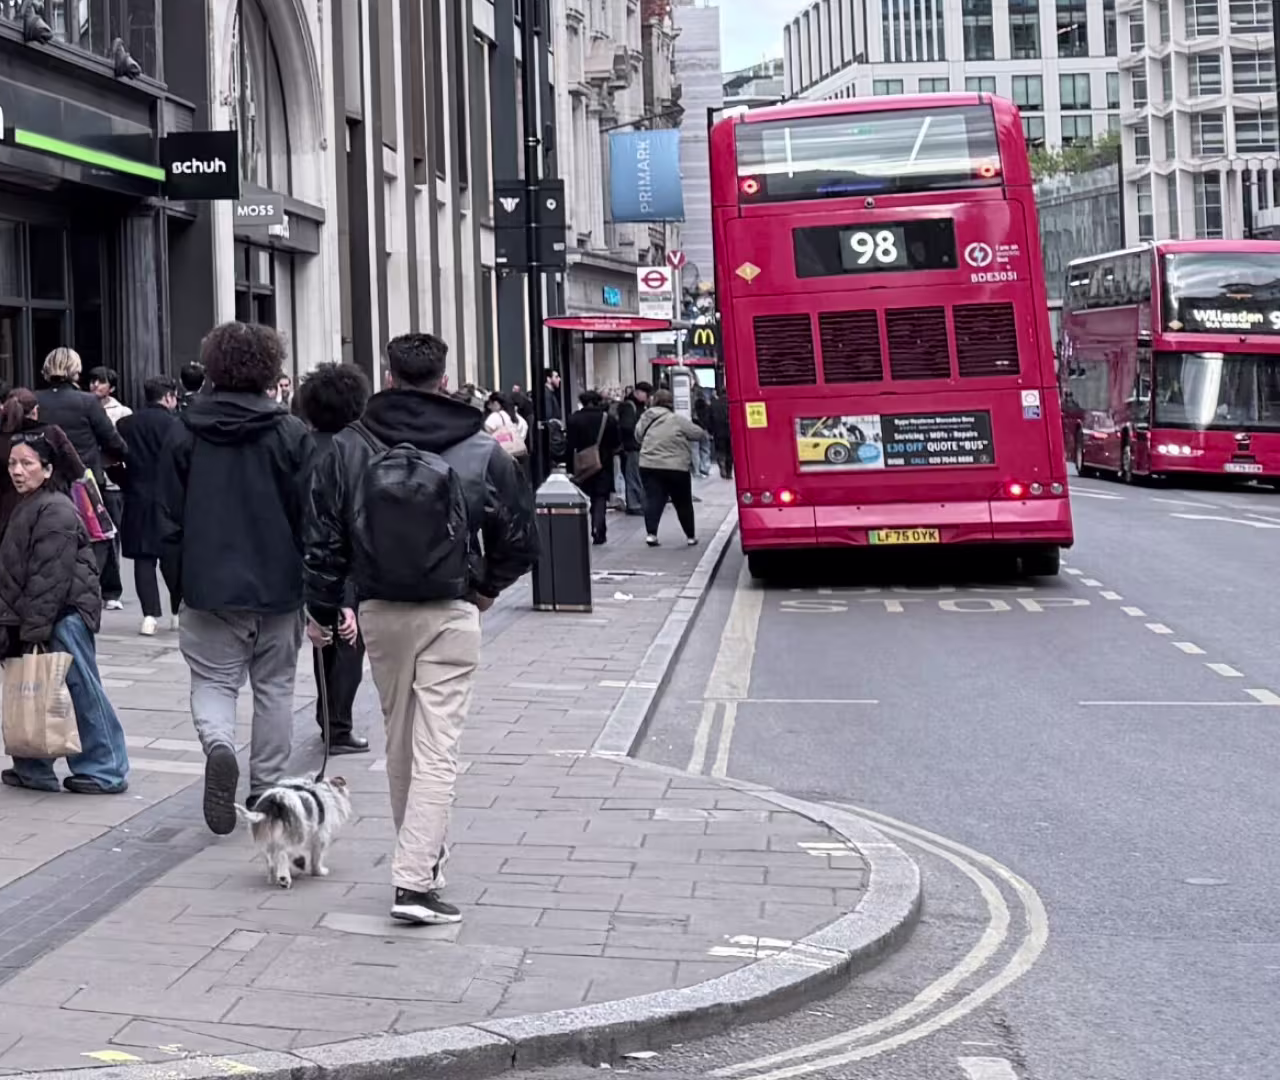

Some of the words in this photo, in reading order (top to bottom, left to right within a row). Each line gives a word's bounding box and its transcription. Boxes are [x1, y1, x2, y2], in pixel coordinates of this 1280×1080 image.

[172, 157, 226, 174] schuh
[637, 139, 654, 214] PRIMARK
[237, 205, 274, 216] MOSS
[850, 230, 897, 264] 98
[1193, 309, 1263, 323] Willesden
[927, 441, 958, 452] QUOTE
[779, 598, 1090, 612] STOP
